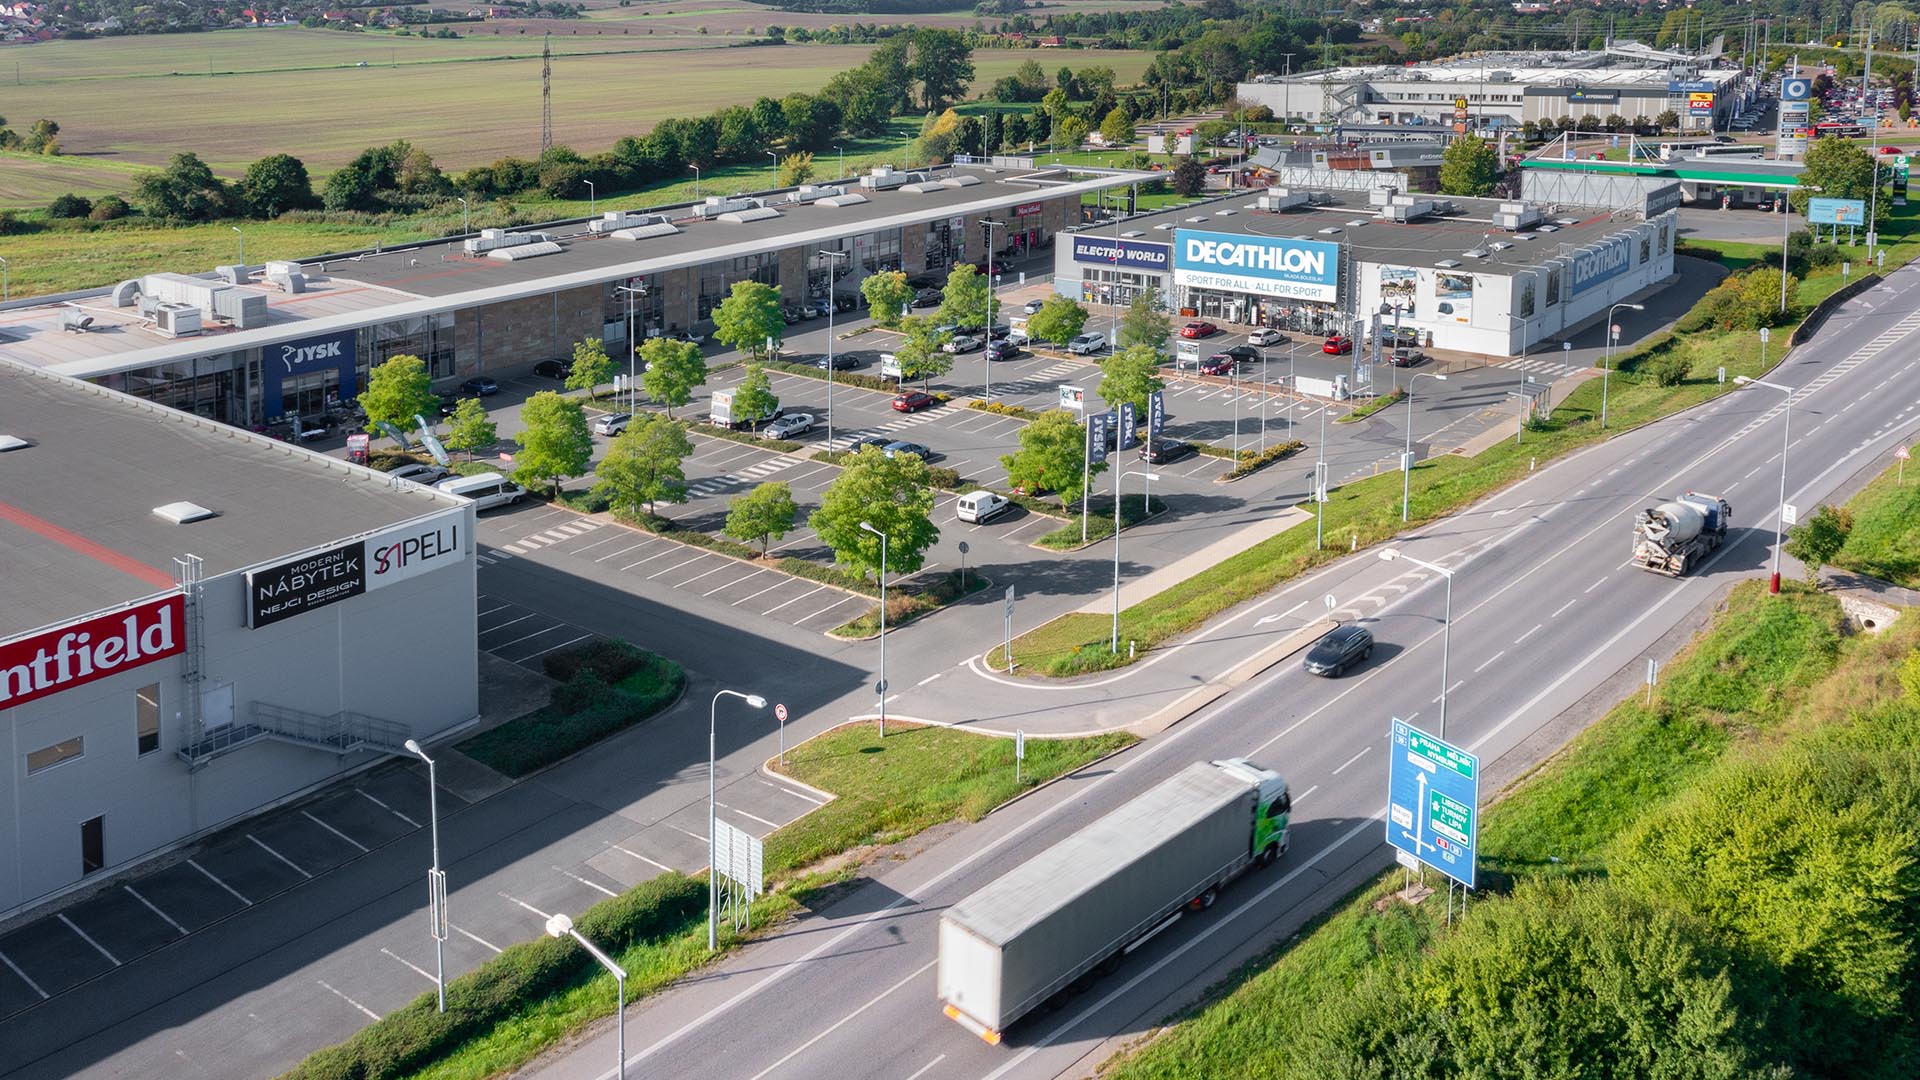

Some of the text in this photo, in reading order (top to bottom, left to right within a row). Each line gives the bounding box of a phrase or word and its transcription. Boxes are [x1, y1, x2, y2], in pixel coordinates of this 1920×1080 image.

[1076, 244, 1166, 263] ELECTRO WORLD
[1187, 238, 1325, 275] DECATHLON
[1575, 241, 1629, 284] DECATHLON
[1186, 275, 1323, 298] SPORT FOR ALL ALL FOR SPORT
[294, 340, 341, 364] JYSK
[1094, 417, 1104, 453] JYSK
[1124, 406, 1132, 440] JYSK
[291, 549, 344, 575] MODERNÍ
[374, 525, 457, 575] SAPELI
[260, 557, 359, 601] NÁBYTEK
[306, 578, 360, 602] DESIGN
[0, 604, 175, 702] ntfield
[1419, 737, 1441, 753] PRAHA
[1427, 750, 1458, 770] NYMBURK
[1441, 797, 1469, 816] LIBEREC
[1441, 806, 1468, 823] TURNOV
